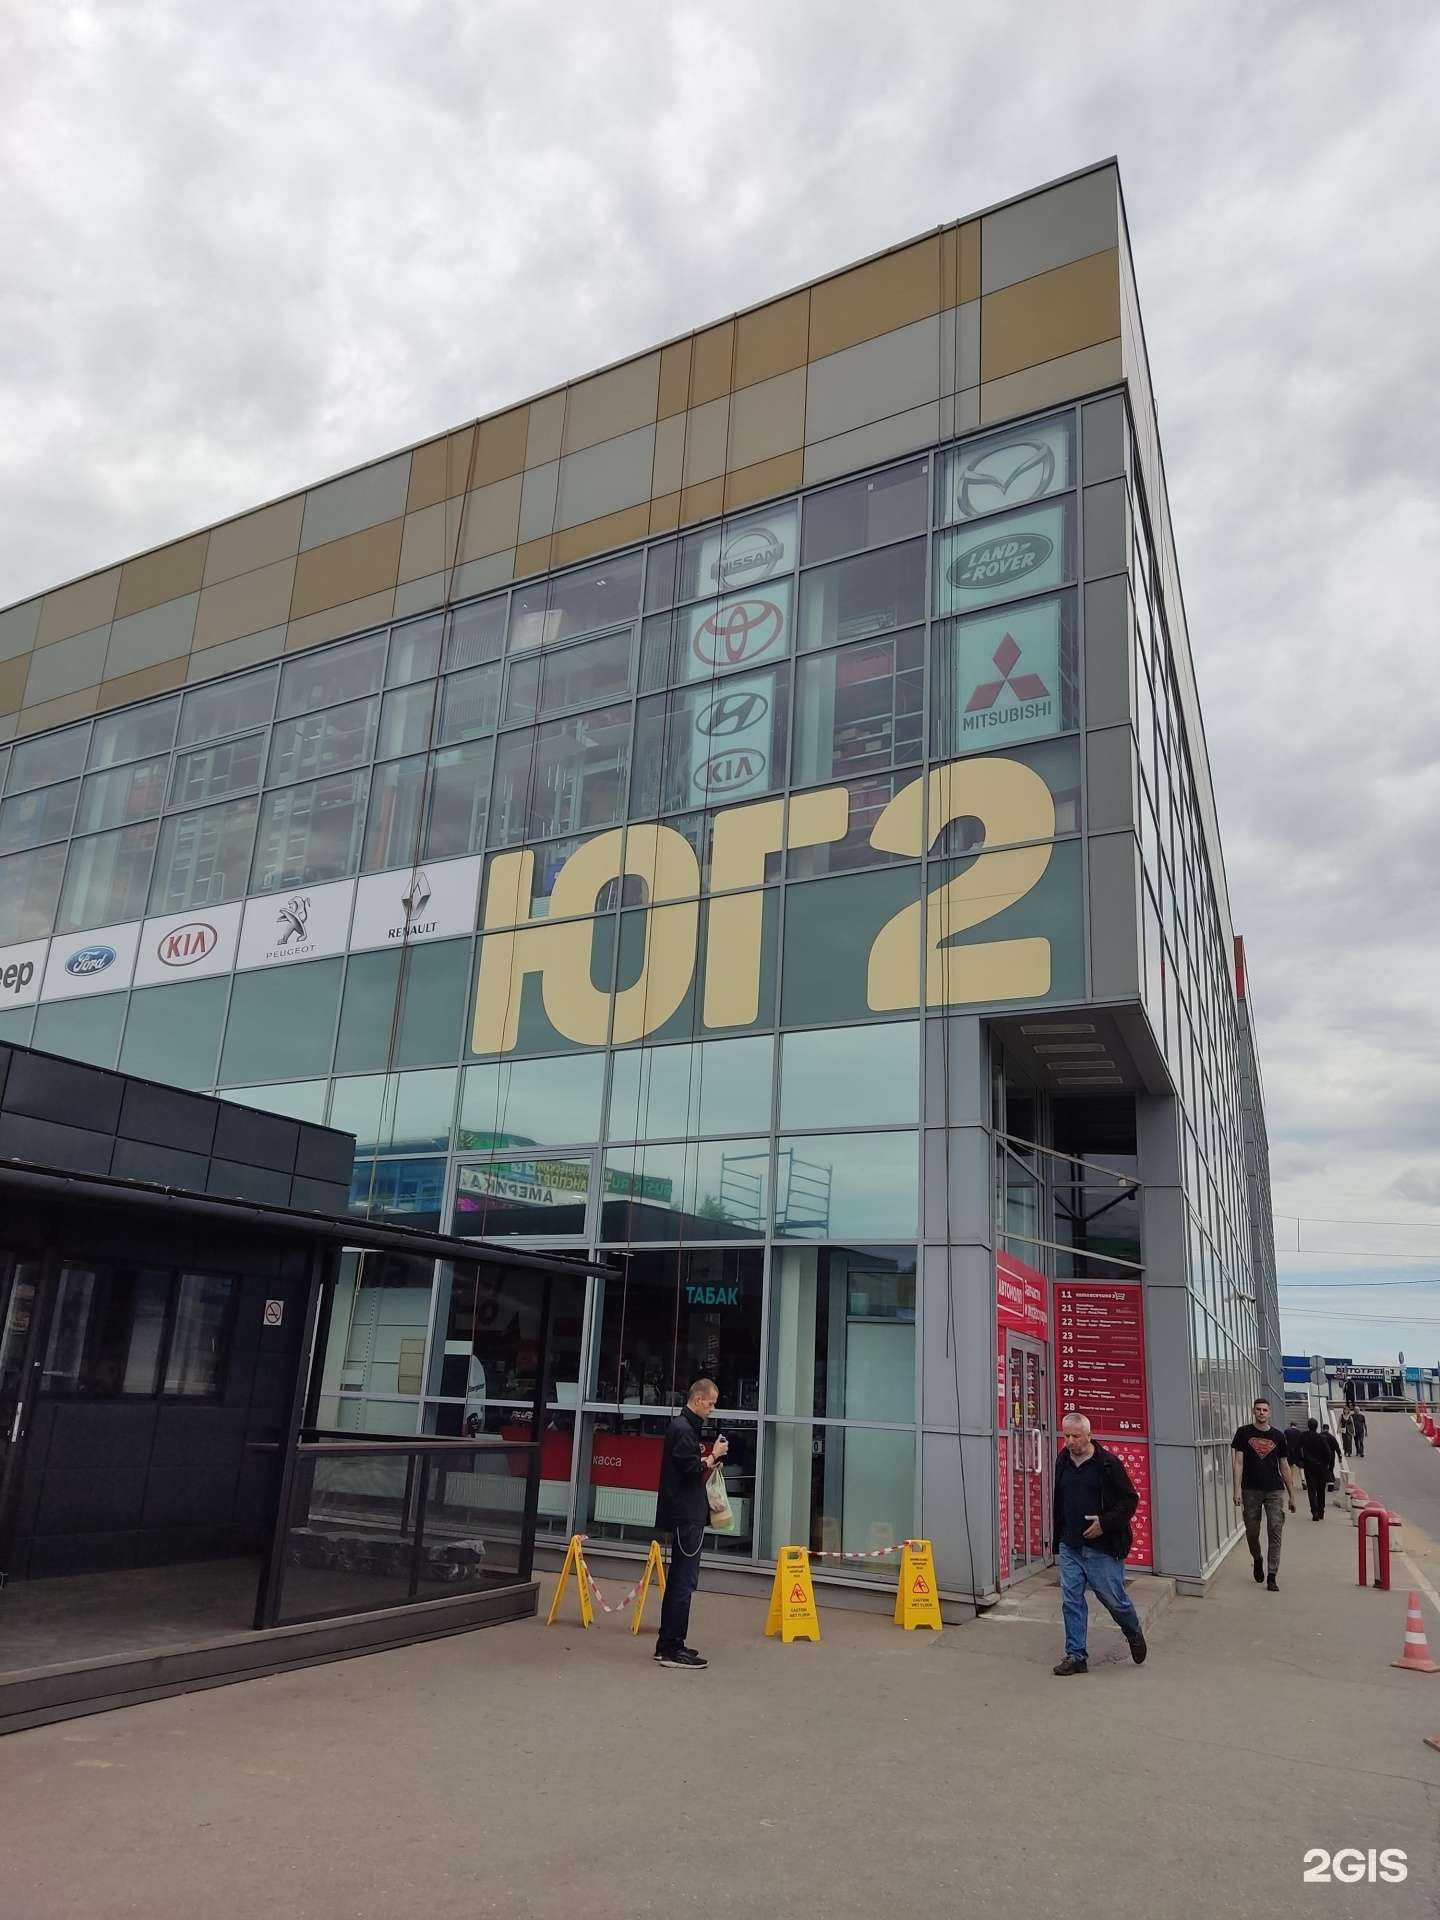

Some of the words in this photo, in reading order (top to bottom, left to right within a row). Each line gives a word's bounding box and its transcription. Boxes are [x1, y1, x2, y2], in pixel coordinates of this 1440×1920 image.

[962, 700, 1052, 732] MITSUBISHI
[706, 753, 753, 784] KIA
[387, 921, 438, 939] RENAULT
[166, 932, 206, 959] KIA
[265, 944, 316, 959] PEUGEOT
[73, 951, 105, 972] Ford
[685, 1285, 740, 1306] ТАБАК
[1061, 1290, 1072, 1299] 11
[1061, 1304, 1072, 1312] 21
[1062, 1318, 1073, 1326] 22
[1062, 1332, 1073, 1340] 23
[1062, 1346, 1074, 1354] 24
[1062, 1360, 1074, 1368] 25
[1063, 1374, 1075, 1382] 26
[1063, 1388, 1075, 1396] 27
[1064, 1403, 1076, 1411] 28
[593, 1455, 622, 1467] касса
